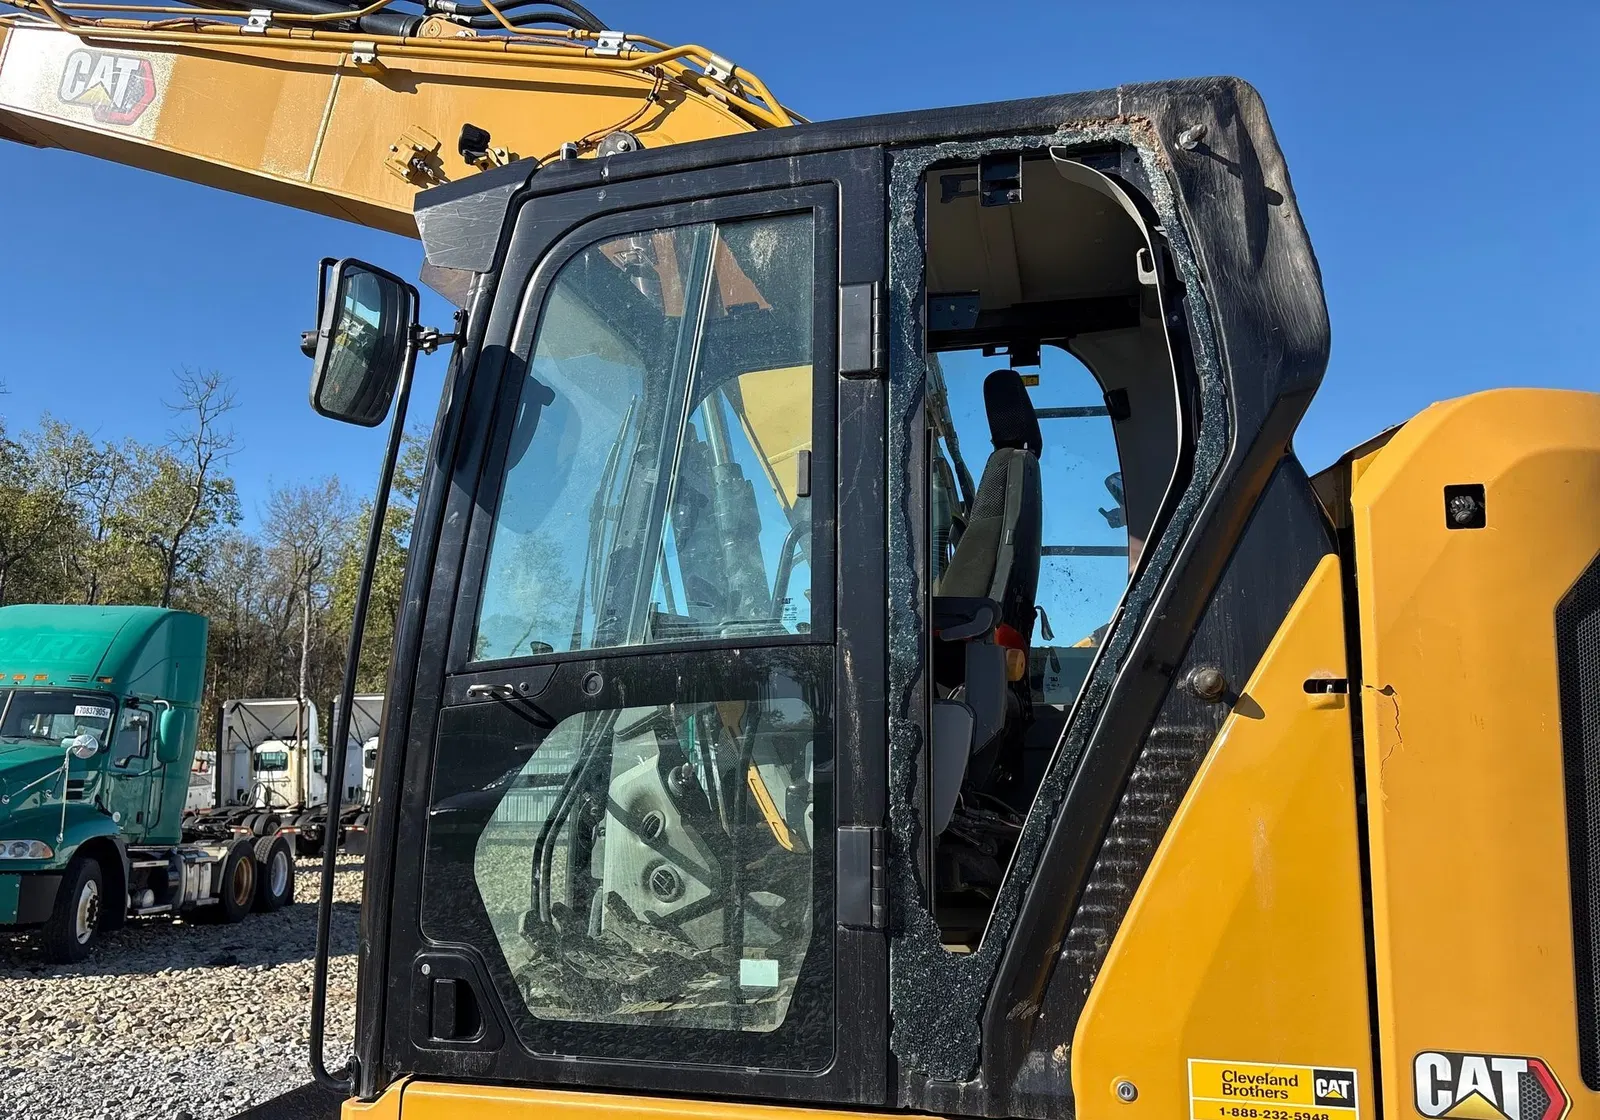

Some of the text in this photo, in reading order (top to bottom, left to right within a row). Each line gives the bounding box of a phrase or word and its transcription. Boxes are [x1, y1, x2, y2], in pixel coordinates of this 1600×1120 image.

[62, 51, 141, 108] CAT
[1221, 1069, 1299, 1087] Cleveland
[1415, 1052, 1528, 1120] CAT
[1222, 1083, 1289, 1100] Brothers
[1315, 1078, 1351, 1100] CAT
[1219, 1106, 1330, 1120] 1-888-232-5948
